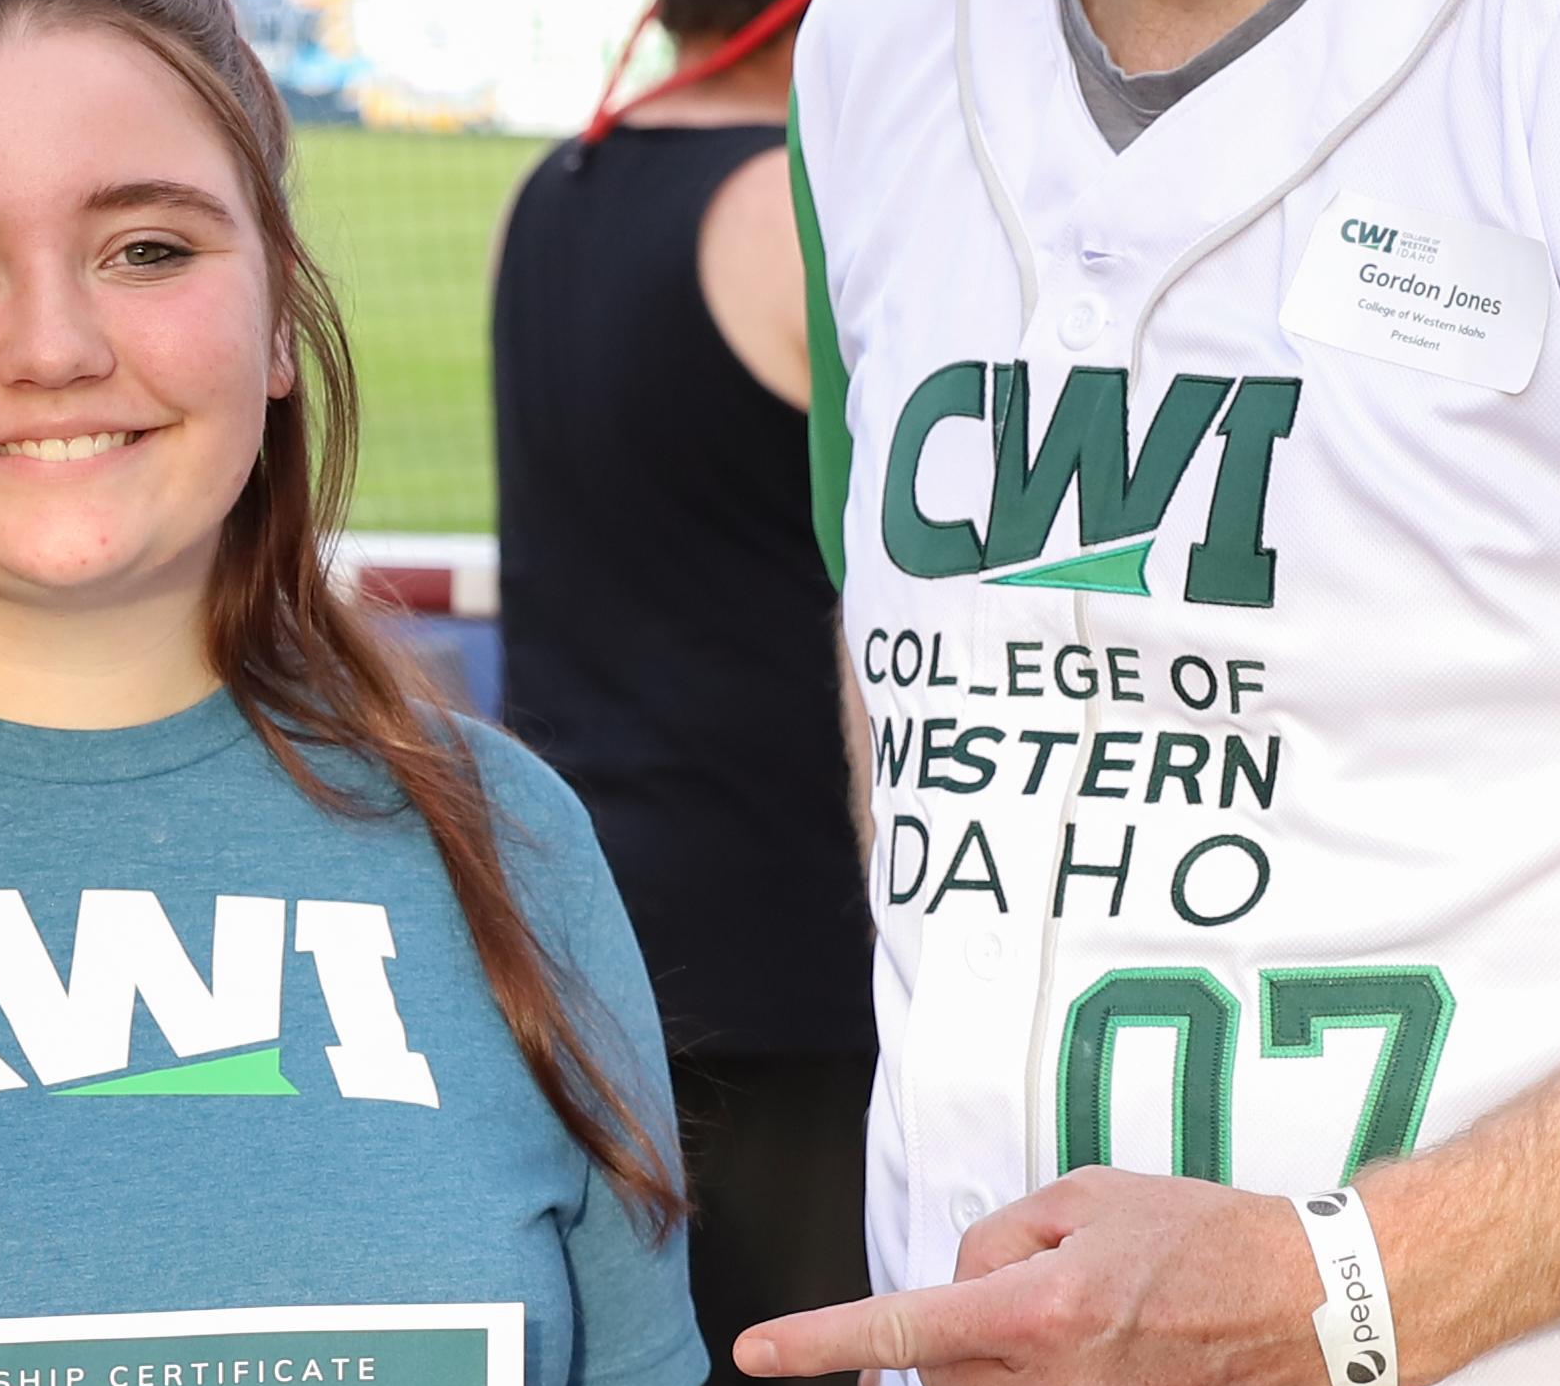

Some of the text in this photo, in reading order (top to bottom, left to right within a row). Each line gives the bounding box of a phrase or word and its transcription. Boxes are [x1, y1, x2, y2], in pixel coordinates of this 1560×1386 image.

[1340, 219, 1398, 253] CWI
[1396, 249, 1436, 264] IDAHO
[1400, 239, 1438, 254] WESTERN
[1358, 299, 1486, 339] College of Western Idaho
[1359, 263, 1502, 315] Gordon Jones
[1390, 329, 1440, 351] President
[882, 358, 1302, 608] CWI
[865, 629, 1266, 714] COLEGE OF
[871, 716, 1280, 809] WESTERN
[888, 816, 1270, 927] DAHO
[1055, 964, 1457, 1187] 07
[1333, 1253, 1380, 1343] pepsi
